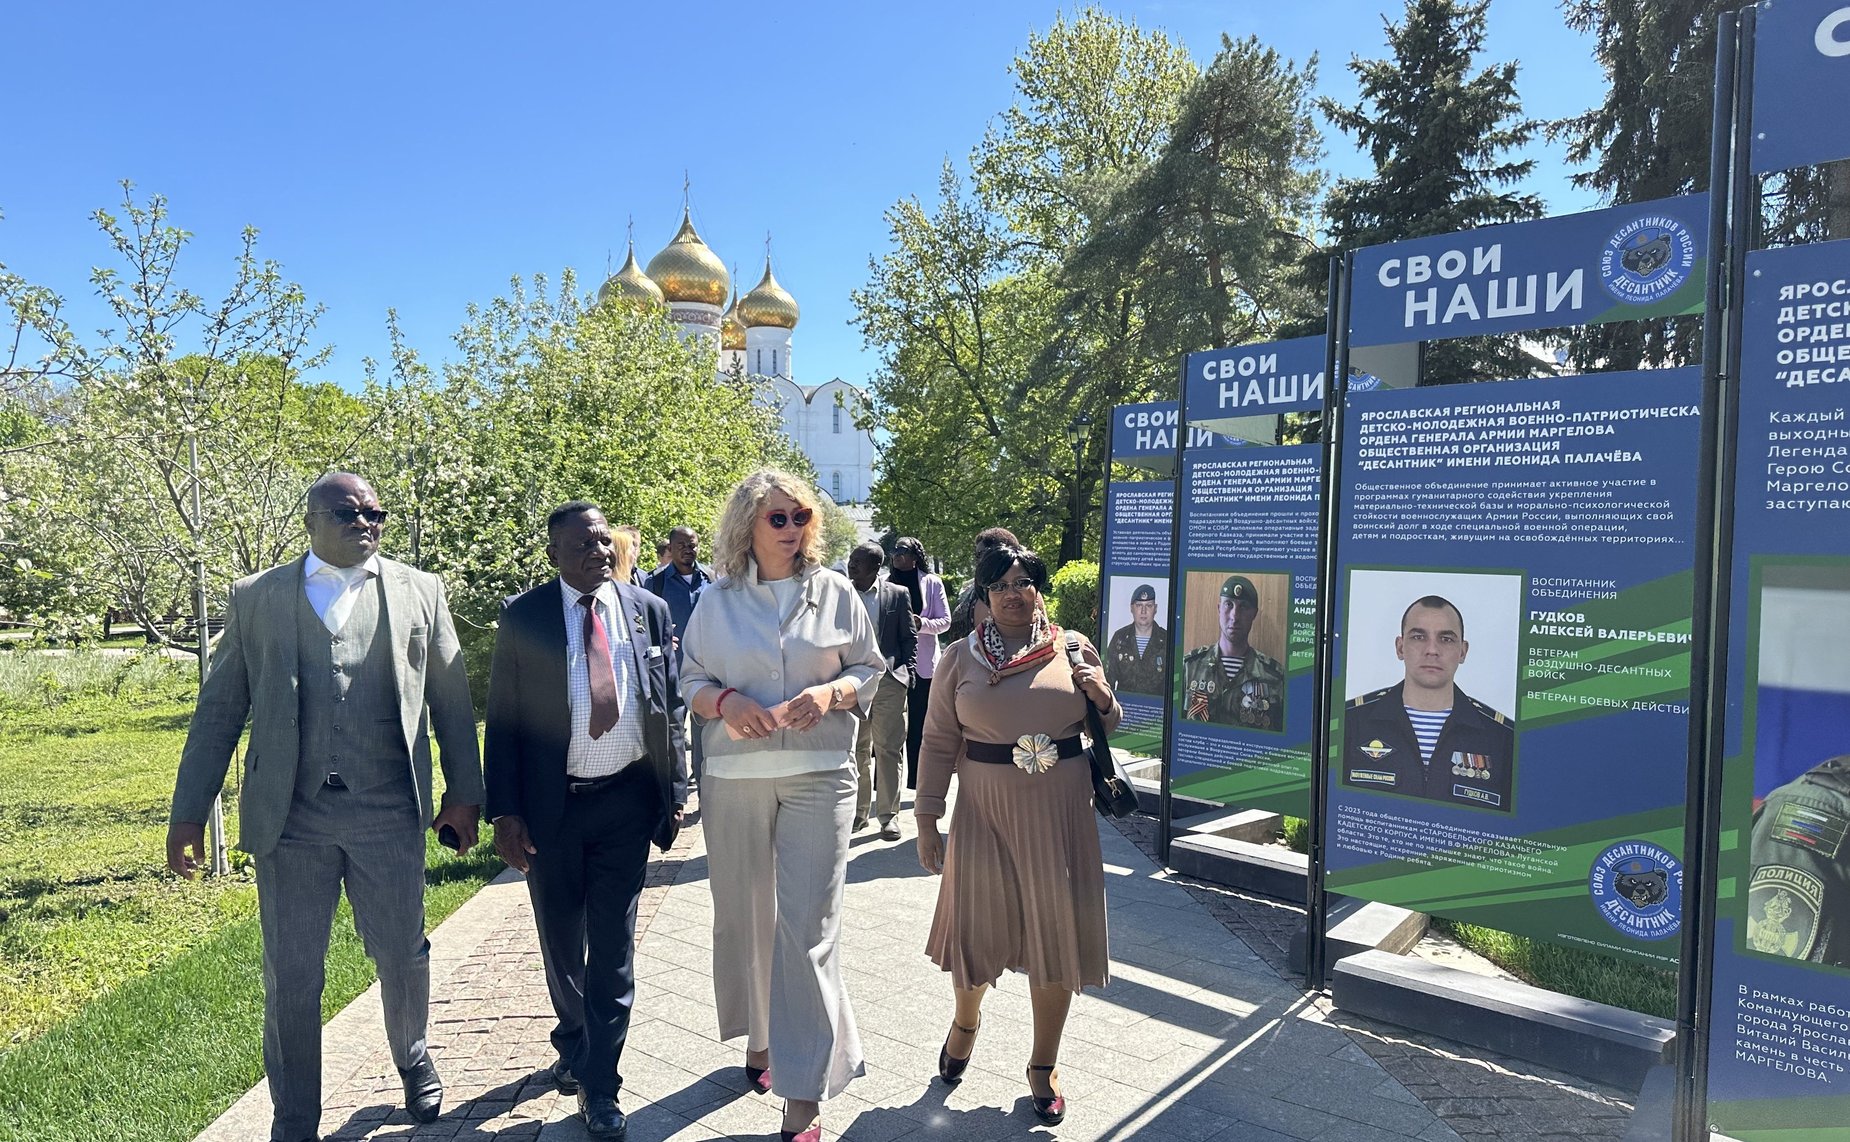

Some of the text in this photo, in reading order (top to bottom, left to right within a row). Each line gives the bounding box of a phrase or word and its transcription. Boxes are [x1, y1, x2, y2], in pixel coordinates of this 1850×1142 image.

[1602, 217, 1693, 277] СОЮЗ ДЕСАНТНИКОВ РОССИИ
[1378, 244, 1502, 287] СВОИ
[1613, 269, 1678, 294] ДЕСАНТНИК
[1779, 280, 1850, 301] ЯРОС
[1404, 268, 1584, 328] НАШИ
[1778, 323, 1850, 343] ОРДЕ
[1202, 353, 1277, 381] СВОИ
[1219, 372, 1324, 409] НАШИ
[1125, 410, 1179, 428] СВОИ
[1361, 400, 1561, 421] ЯРОСЛАВСКАЯ РЕГИОНАЛЬНАЯ
[1769, 408, 1844, 423] Каждый
[1359, 418, 1505, 434] ДЕТСКО-МОЛОДЕЖНАЯ
[1359, 425, 1615, 446] ОРДЕНА ГЕНЕРАЛА АРМИИ МАРГЕЛОВА
[1359, 441, 1560, 457] ОБЩЕСТВЕННАЯ ОРГАНИЗАЦИЯ
[1767, 446, 1847, 458] Легенда
[1193, 458, 1313, 470] ЯРОСЛАВСКАЯ РЕГИОНАЛЬНАЯ
[1447, 457, 1491, 467] ИМЕНИ
[1494, 455, 1560, 466] ЛЕОНИДА
[1565, 450, 1642, 464] ПАЛАЧЁВА
[1192, 468, 1280, 478] ДЕТСКО-МОЛОДЕЖНАЯ
[1767, 463, 1824, 477] Герою
[1192, 485, 1312, 495] ОБЩЕСТВЕННАЯ ОРГАНИЗАЦИЯ
[1355, 483, 1422, 491] Общественное
[1425, 482, 1489, 490] объединение
[1492, 481, 1546, 489] принимает
[1602, 479, 1646, 488] участие
[1767, 480, 1849, 494] Маргело
[1273, 494, 1312, 502] ЛЕОНИДА
[1354, 491, 1612, 501] программах гуманитарного содействия укрепления
[1354, 501, 1476, 511] материально-технической
[1479, 501, 1503, 510] базы
[1516, 500, 1670, 510] морально-психологической
[1353, 512, 1674, 521] стойкости военнослужащих Армии России, выполняющих свой
[1353, 522, 1395, 530] воинский
[1398, 523, 1419, 531] долг
[1431, 523, 1452, 531] ходе
[1455, 523, 1520, 531] специальной
[1524, 522, 1567, 531] военной
[1571, 524, 1628, 532] операции,
[1389, 533, 1447, 542] подросткам,
[1450, 534, 1495, 542] живущим
[1513, 534, 1598, 543] освобождённых
[1532, 578, 1616, 588] ВОСПИТАННИК
[1531, 588, 1617, 600] ОБЪЕДИНЕНИЯ
[1530, 611, 1585, 623] ГУДКОВ
[1530, 624, 1593, 638] АЛЕКСЕЙ
[1529, 648, 1578, 659] ВЕТЕРАН
[1528, 659, 1672, 678] ВОЗДУШНО-ДЕСАНТНЫХ
[1528, 669, 1566, 680] ВОЙСК
[1527, 691, 1689, 715] ВЕТЕРАН БОЕВЫХ ДЕЙСТВИ
[1338, 814, 1363, 822] помощь
[1365, 819, 1417, 832] воспитанникам
[1495, 841, 1542, 855] КАЗАЧЬЕГО
[1345, 806, 1360, 814] 2023
[1380, 813, 1429, 826] общественное
[1431, 823, 1480, 835] объединение
[1482, 832, 1521, 842] оказывает
[1523, 839, 1567, 851] посильную
[1337, 820, 1382, 833] КАДЕТСКОГО
[1385, 829, 1417, 840] КОРПУСА
[1420, 835, 1446, 845] ИМЕНИ
[1517, 854, 1558, 866] Луганской
[1343, 844, 1372, 854] любовью
[1380, 850, 1405, 860] Родине
[1337, 834, 1348, 842] Это
[1430, 853, 1475, 867] заряженные
[1477, 862, 1532, 878] патриотизмом
[1426, 846, 1461, 856] наслышке
[1504, 860, 1525, 869] такое
[1593, 844, 1676, 895] СОЮЗ ДЕСАНТНИКОВ
[1757, 869, 1818, 898] ПОЛИЦИЯ
[1605, 899, 1675, 929] ДЕСАНТНИК
[1618, 922, 1648, 937] ЛЕОНИДА
[1739, 984, 1747, 994] В
[1753, 990, 1804, 1007] рамках
[1738, 998, 1848, 1031] Командующего
[1737, 1013, 1850, 1046] города Яросла
[1737, 1024, 1795, 1046] Виталий
[1736, 1039, 1785, 1057] камень
[1804, 1056, 1844, 1072] честь
[1736, 1050, 1831, 1083] МАРГЕЛОВА.
